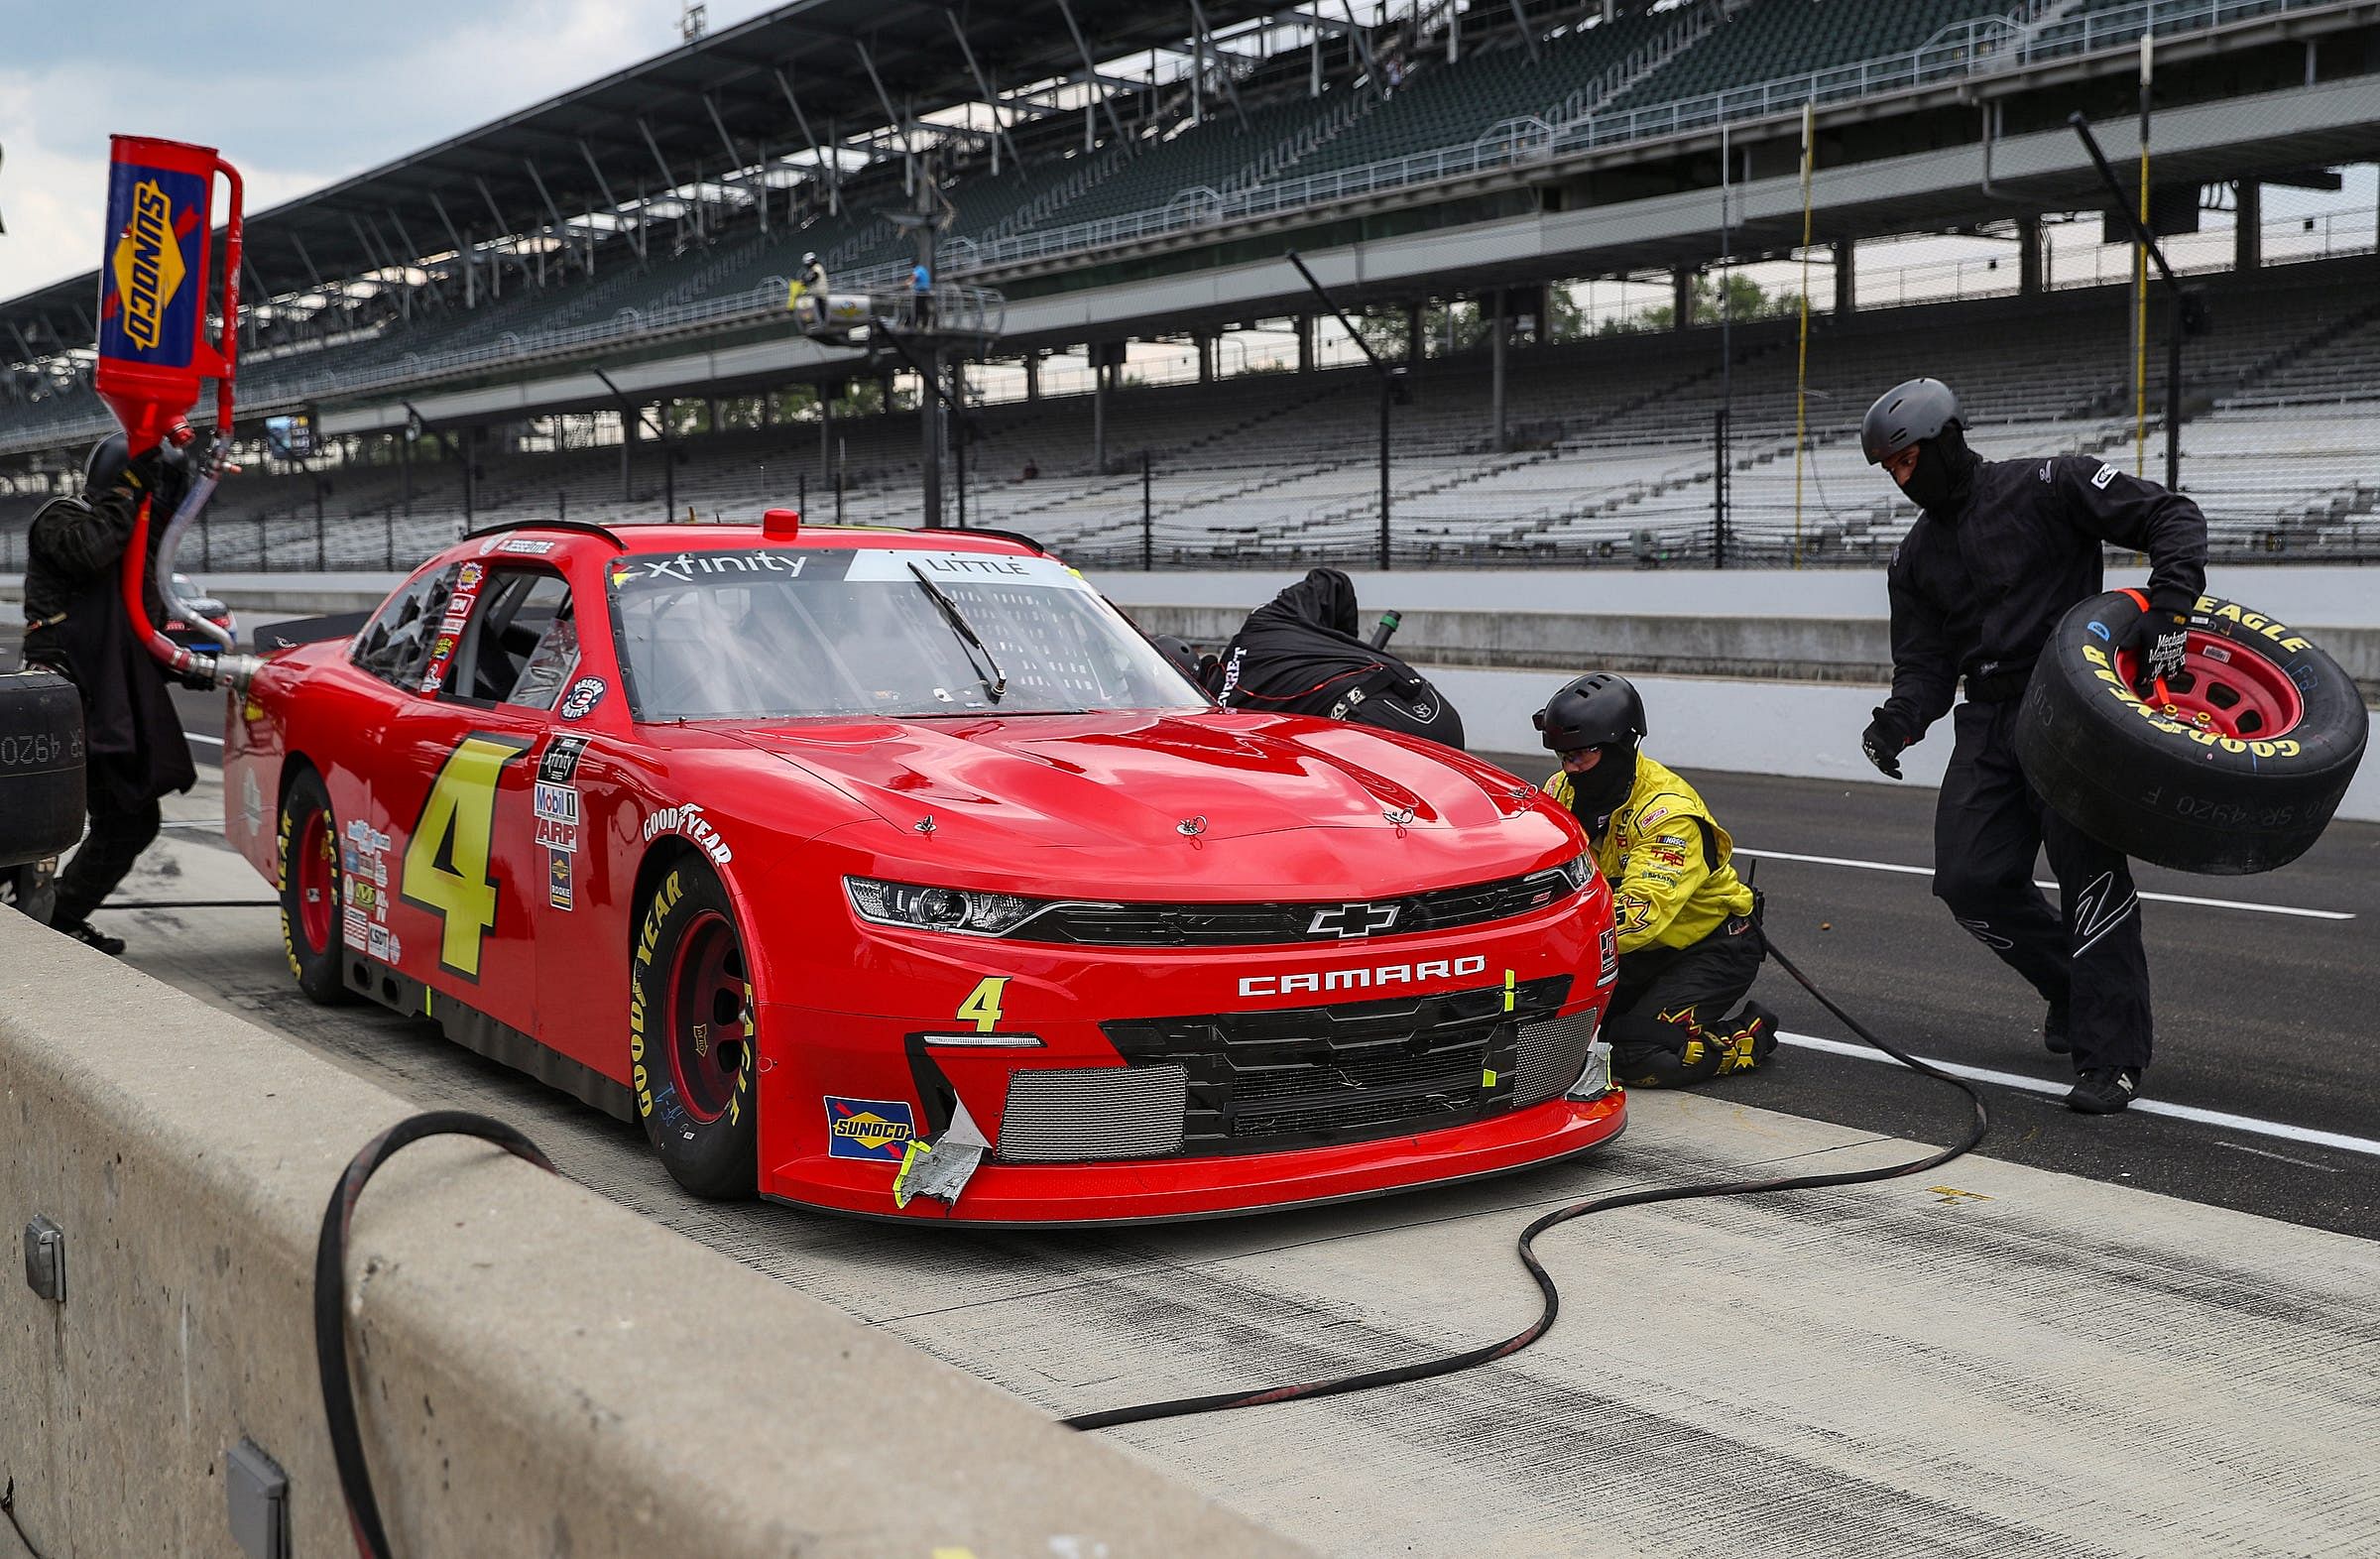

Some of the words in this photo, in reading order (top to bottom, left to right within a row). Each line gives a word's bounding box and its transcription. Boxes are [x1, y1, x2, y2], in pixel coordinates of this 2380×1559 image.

[129, 185, 166, 344] SUNOCO
[644, 554, 807, 583] xfinity
[926, 558, 1032, 576] LITTLE
[2194, 595, 2313, 655] EAGLE
[2082, 645, 2302, 758] GOODYEAR
[1, 734, 60, 766] 4920
[536, 784, 564, 815] Mobil
[566, 791, 575, 816] 1
[400, 732, 532, 982] 4
[536, 817, 576, 846] ARP
[644, 802, 733, 868] GOODYEAR
[631, 870, 683, 1118] GOODYEAR
[955, 975, 1013, 1033] 4
[1239, 954, 1487, 998] CAMARO
[835, 1119, 907, 1139] SUNOCO
